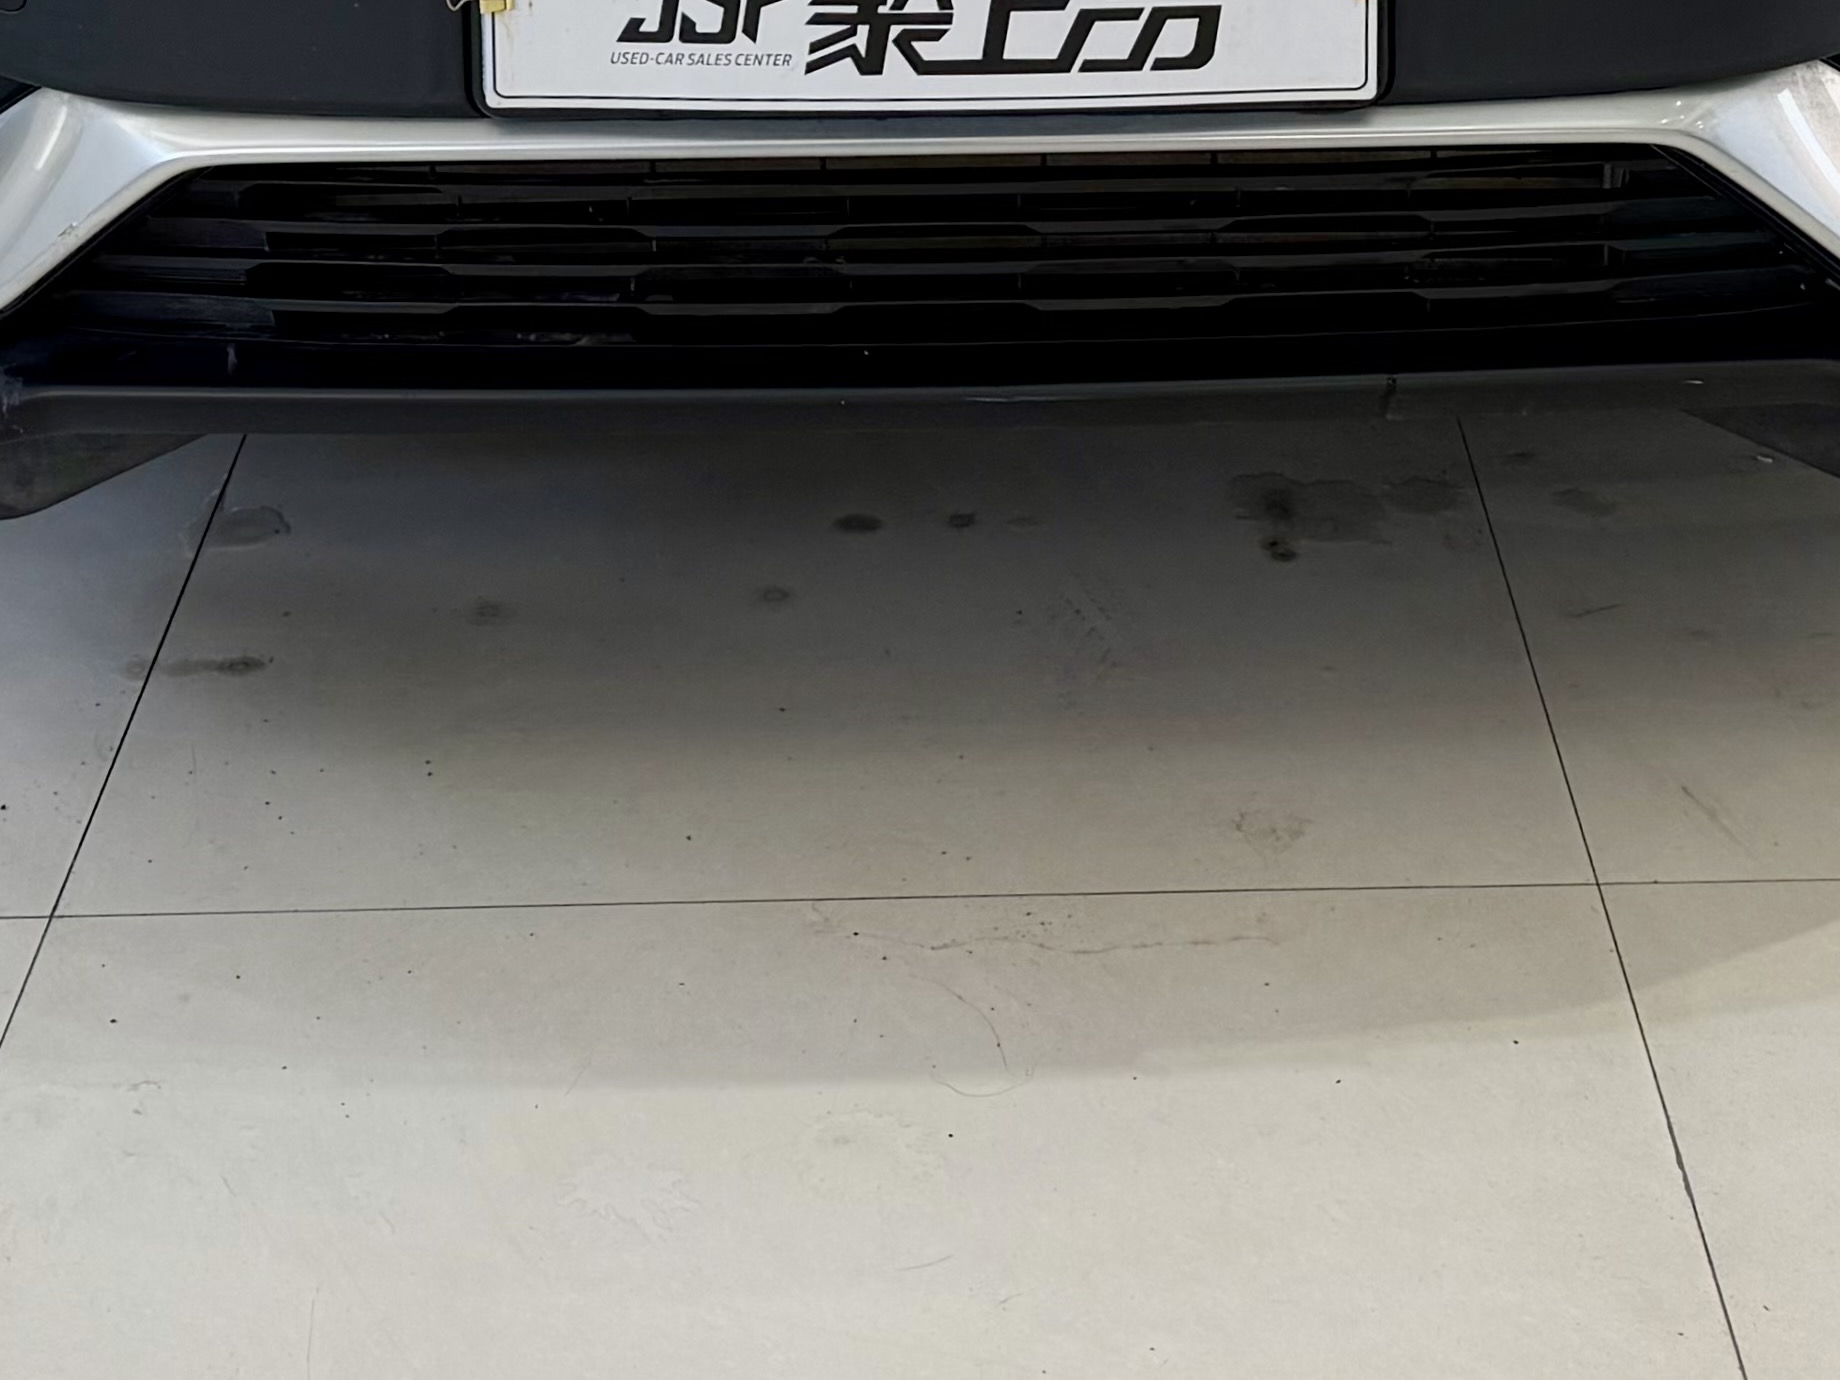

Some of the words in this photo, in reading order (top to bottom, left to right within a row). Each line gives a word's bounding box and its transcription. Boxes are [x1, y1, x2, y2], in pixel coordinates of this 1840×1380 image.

[610, 51, 685, 66] USED-CAR
[688, 52, 732, 67] SALES
[735, 53, 793, 68] CENTER
